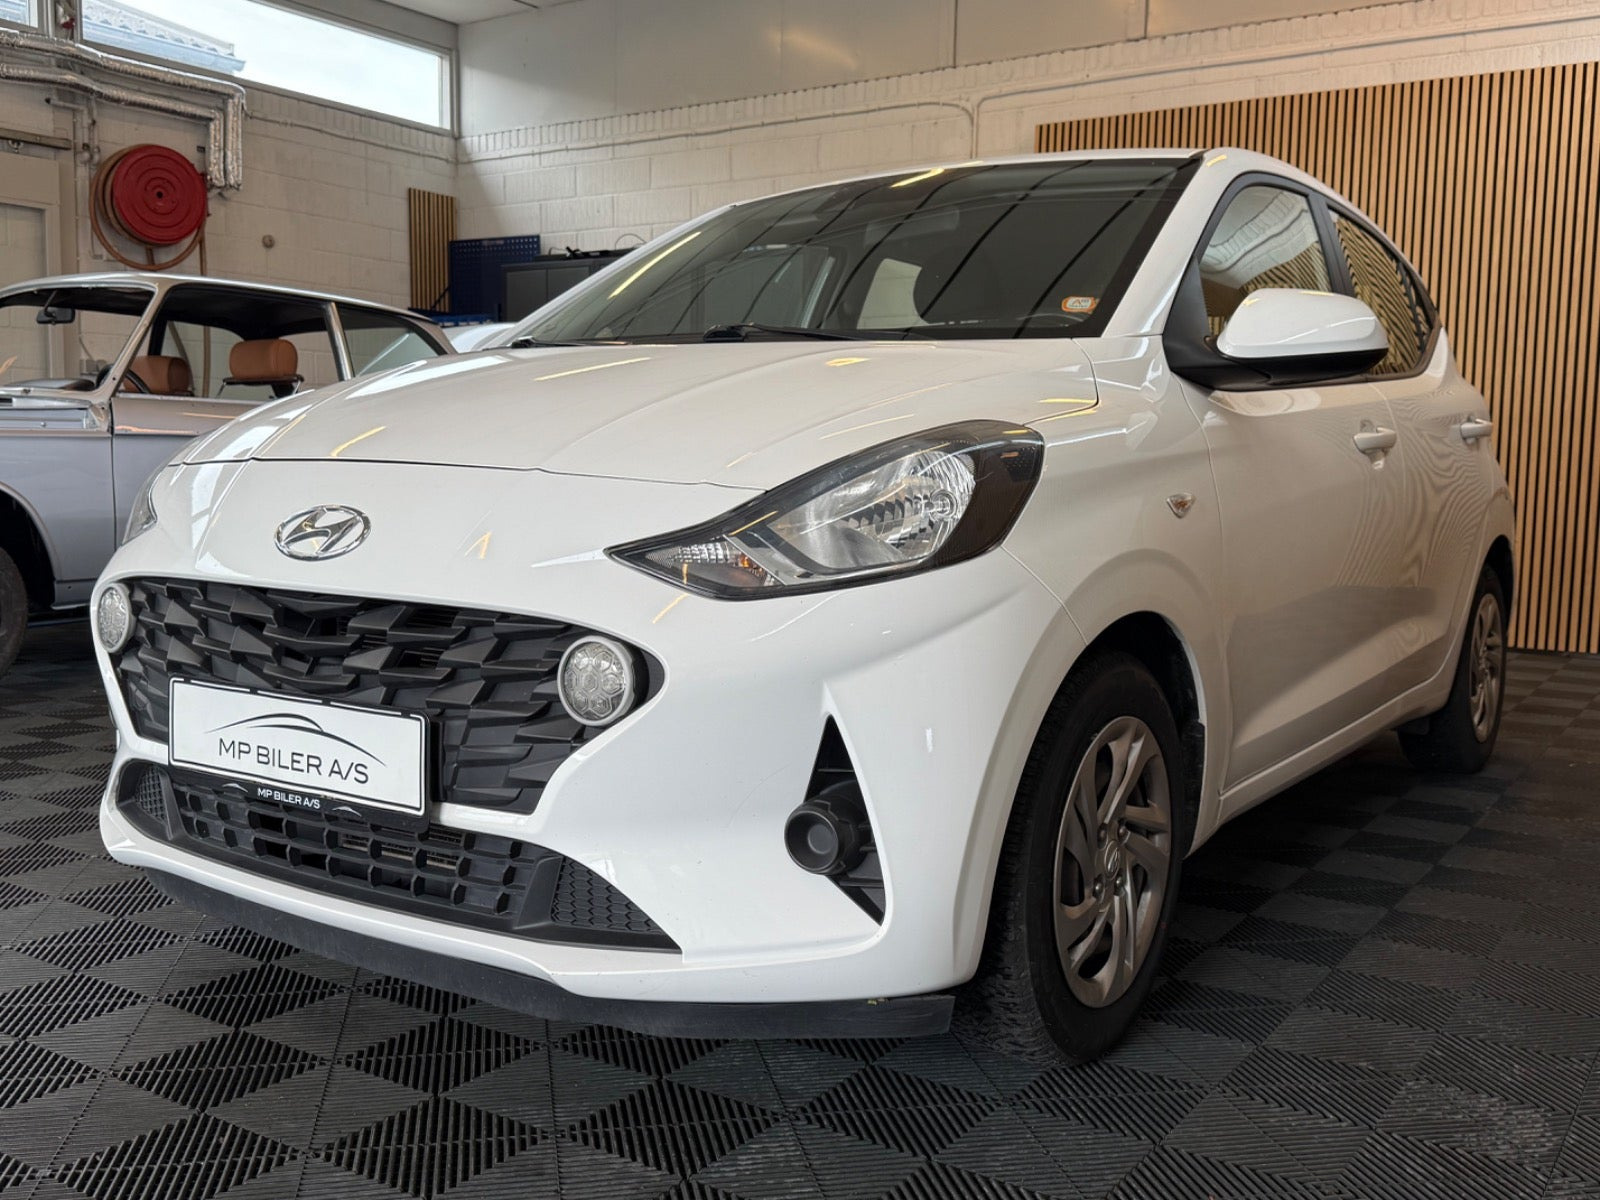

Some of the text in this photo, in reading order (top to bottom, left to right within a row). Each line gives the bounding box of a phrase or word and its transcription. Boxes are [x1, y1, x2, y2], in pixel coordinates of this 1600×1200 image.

[219, 737, 369, 784] MP BILER A/S
[257, 787, 320, 809] MP BILER A/S
